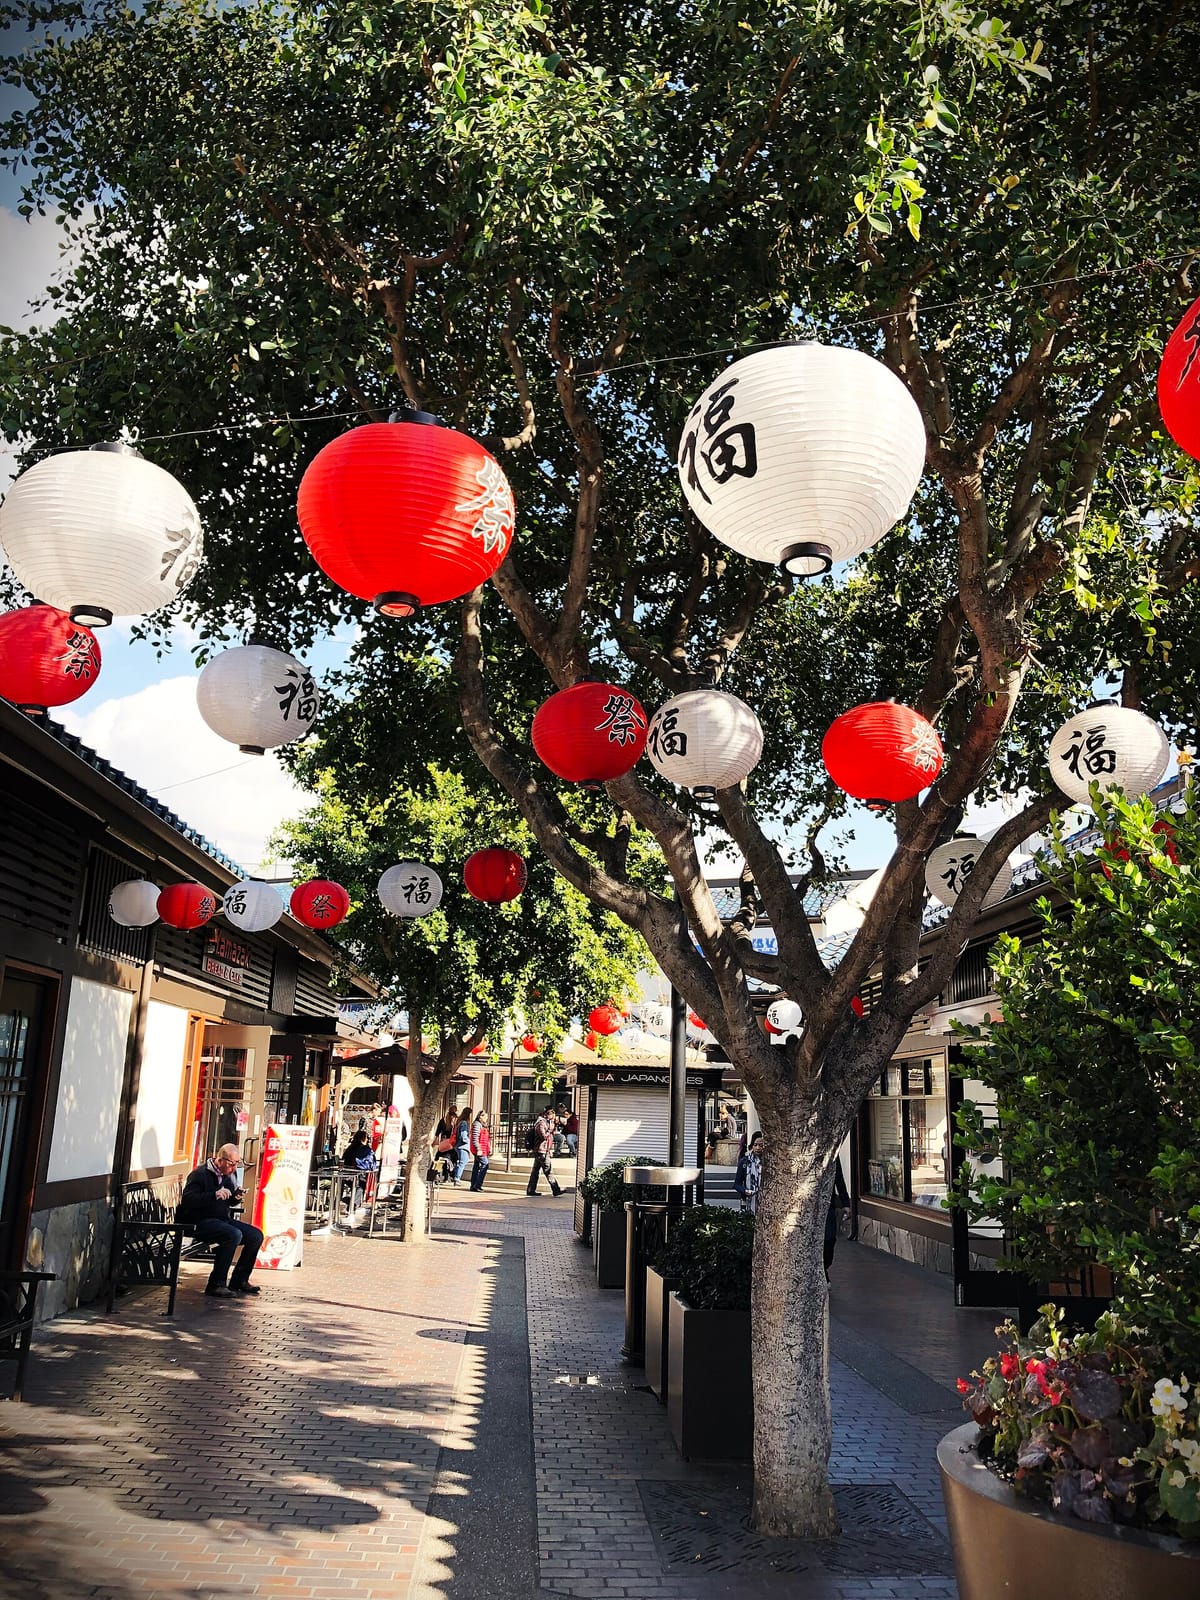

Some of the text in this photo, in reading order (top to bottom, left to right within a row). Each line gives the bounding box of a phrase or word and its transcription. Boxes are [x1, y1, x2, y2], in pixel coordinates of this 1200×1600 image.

[680, 378, 758, 505] 福
[455, 455, 515, 553] 祭
[53, 631, 99, 679] 祭
[274, 666, 320, 722] 福
[594, 695, 645, 747] 祭
[648, 708, 688, 763] 福
[903, 720, 943, 772] 祭
[1060, 725, 1117, 780] 福
[225, 889, 247, 915] 福
[309, 895, 337, 920] 祭
[401, 876, 432, 904] 福
[597, 1072, 614, 1081] LA
